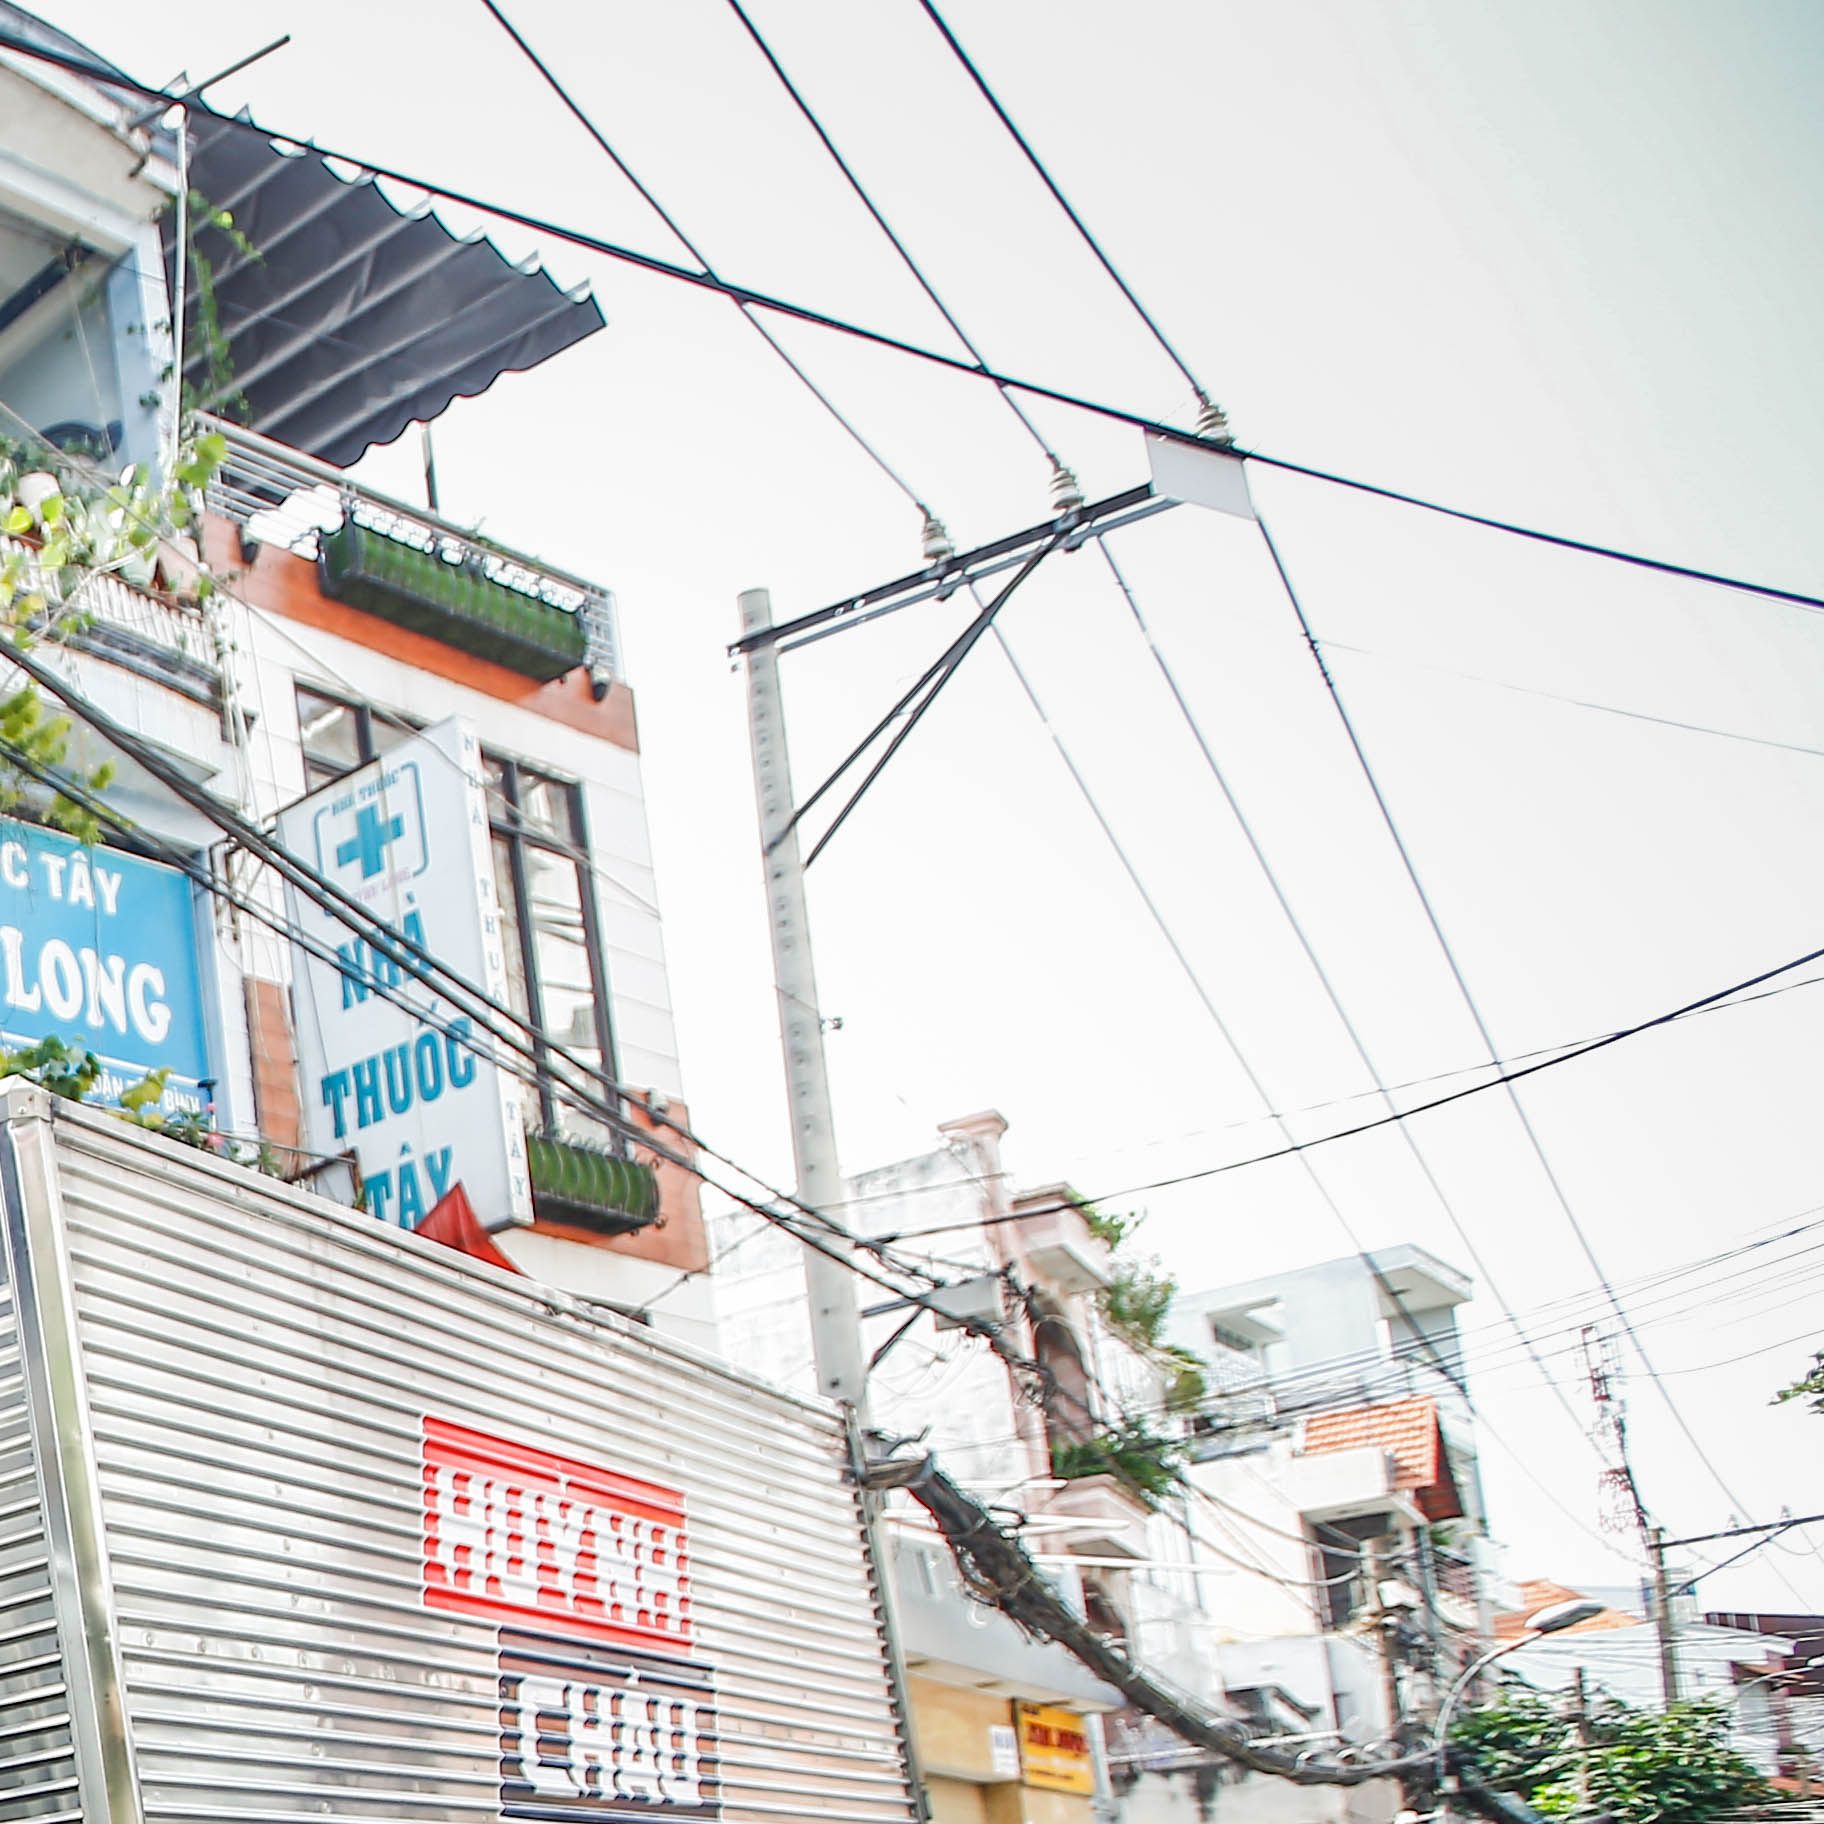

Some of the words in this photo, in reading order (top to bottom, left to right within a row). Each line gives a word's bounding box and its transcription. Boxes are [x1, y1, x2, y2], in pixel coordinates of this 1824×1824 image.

[39, 850, 122, 917] TÂY
[336, 892, 431, 1012] NHÀ
[321, 1000, 477, 1140] THUỐC
[360, 1141, 455, 1230] TÂY
[434, 1463, 690, 1633] HUỲNH
[520, 1666, 704, 1806] CHÂU
